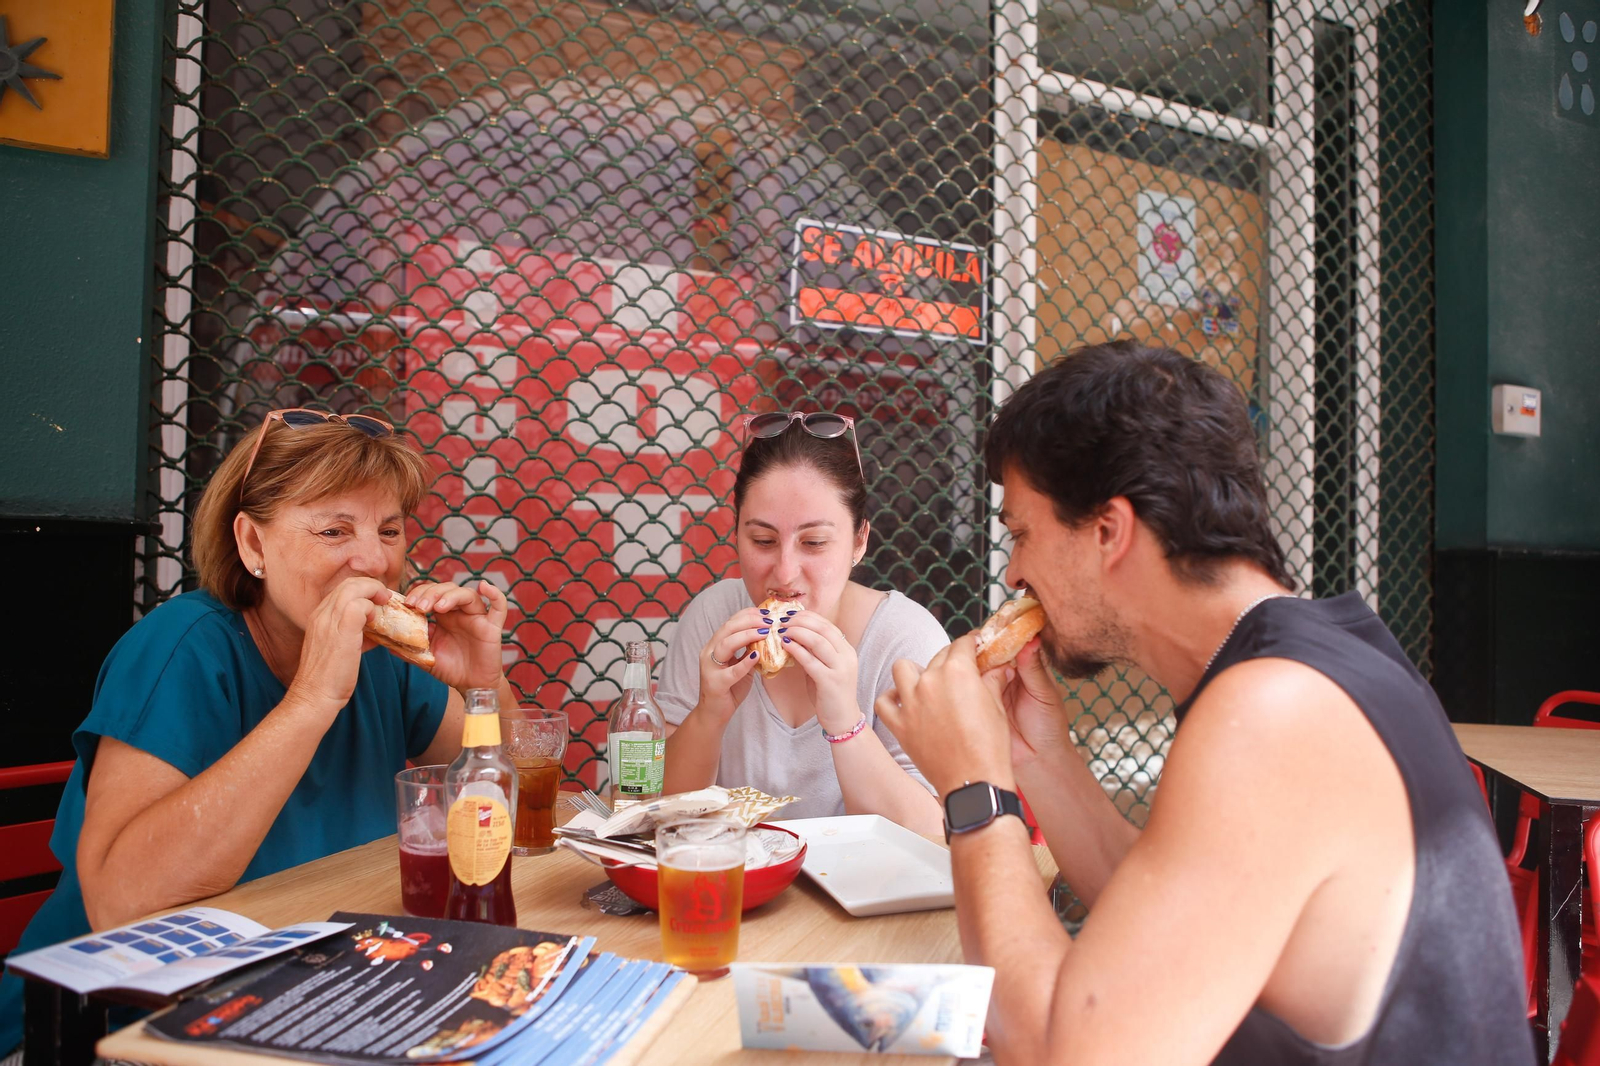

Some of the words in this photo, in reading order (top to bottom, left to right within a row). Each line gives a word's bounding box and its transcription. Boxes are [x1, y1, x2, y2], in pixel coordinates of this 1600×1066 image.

[441, 239, 519, 667] LIQUIDA
[801, 226, 844, 265] SE
[851, 234, 982, 285] ALQUILA
[561, 253, 722, 783] TOTA
